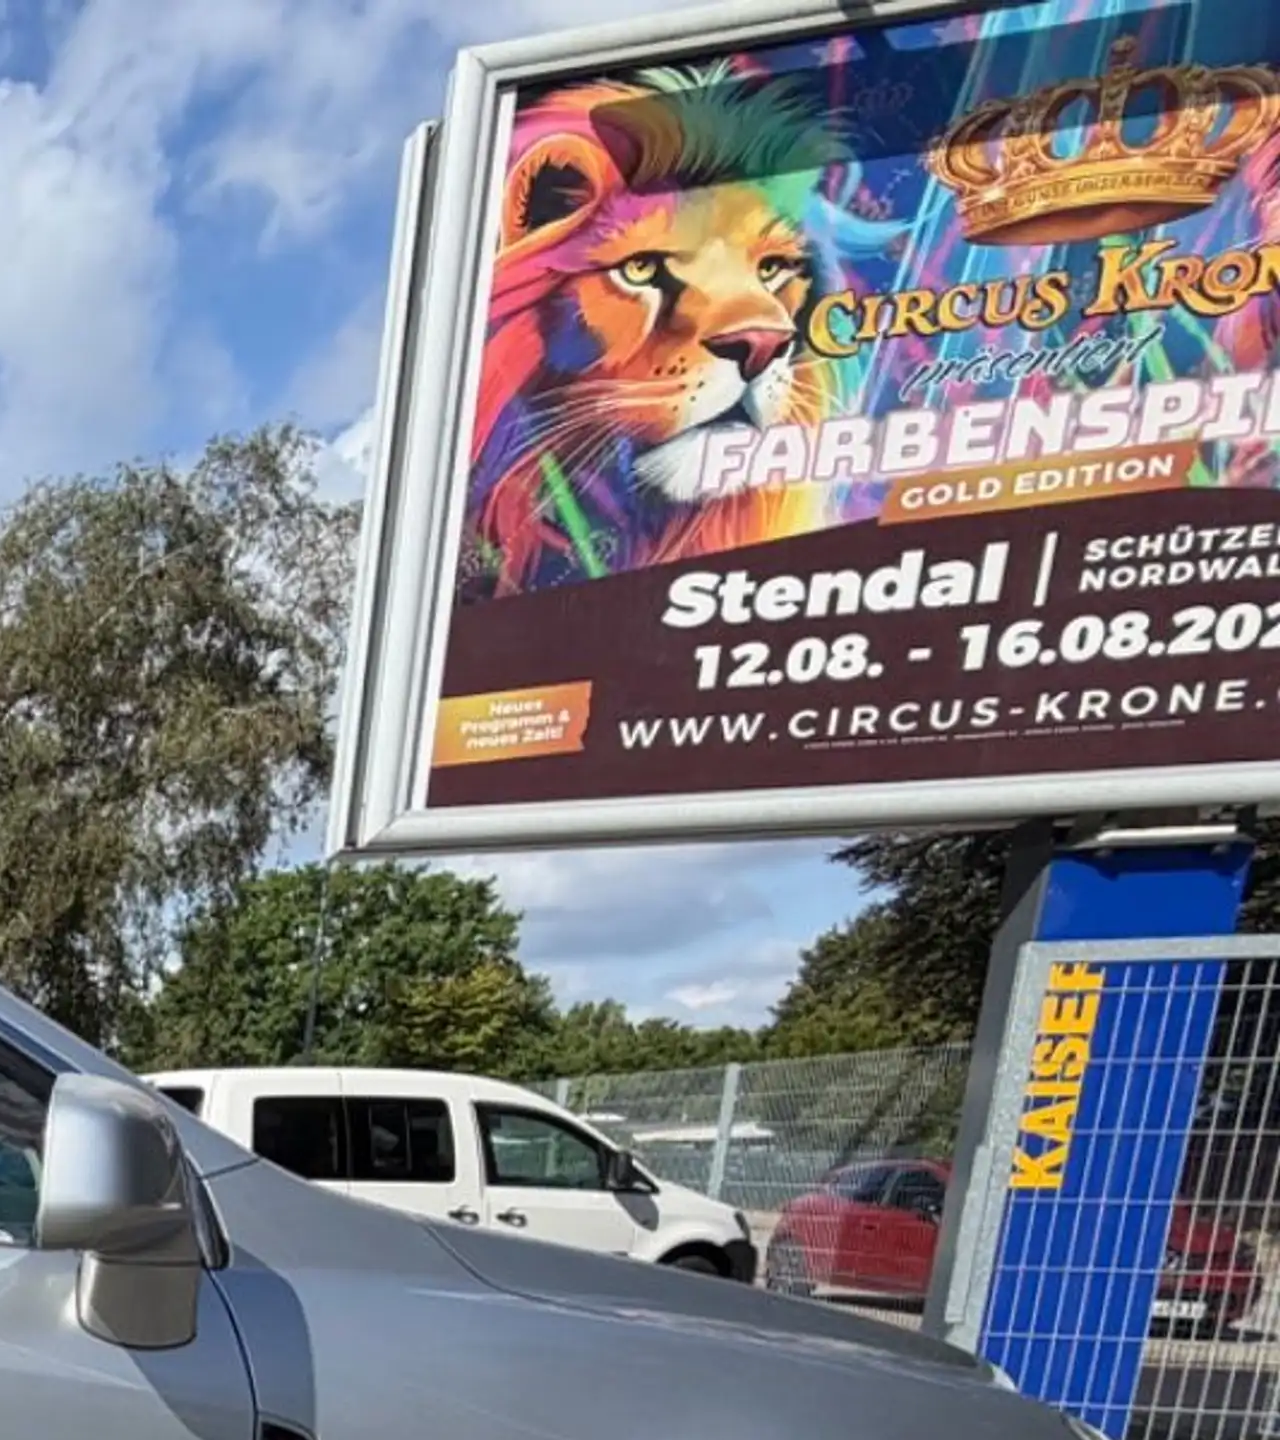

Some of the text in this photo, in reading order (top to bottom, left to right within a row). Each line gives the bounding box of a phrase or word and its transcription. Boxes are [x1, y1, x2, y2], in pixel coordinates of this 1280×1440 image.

[808, 271, 1069, 357] CIRCUS
[899, 323, 1166, 401] präsentiert
[900, 454, 1175, 510] GOLD EDITION
[1084, 523, 1280, 561] SCHÜTZE
[661, 541, 1010, 628] Stendal
[694, 633, 884, 690] 12.08.
[460, 713, 553, 735] Programm
[619, 680, 1280, 749] WWW.CIRCUS-KRONE.
